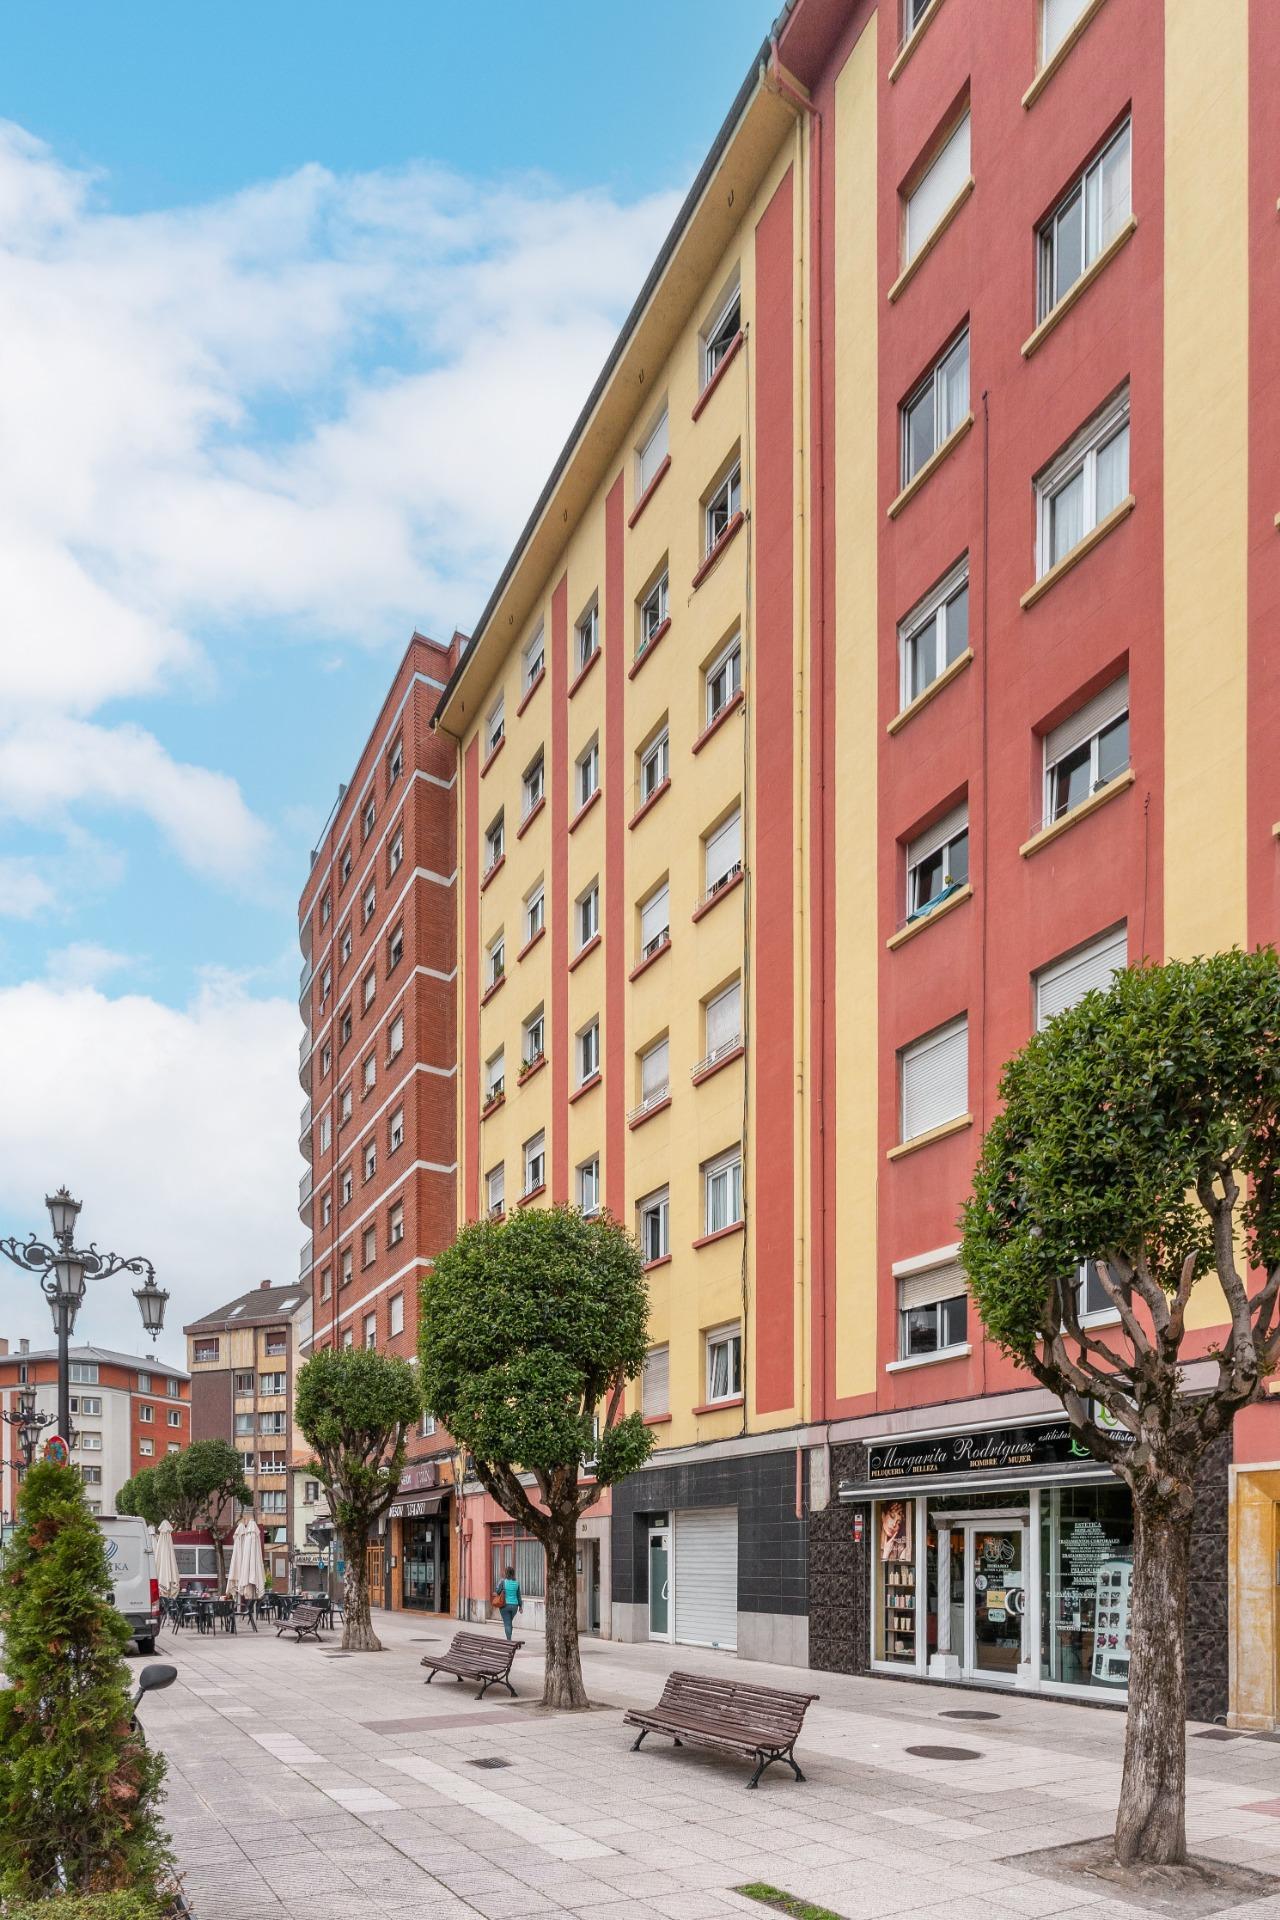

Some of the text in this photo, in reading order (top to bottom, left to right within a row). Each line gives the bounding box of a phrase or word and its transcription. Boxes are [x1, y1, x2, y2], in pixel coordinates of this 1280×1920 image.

[1038, 1429, 1071, 1441] estilistas
[1109, 1430, 1137, 1442] tilistas
[871, 1446, 947, 1473] Margarita
[871, 1454, 1032, 1477] PELUQUERIA BELLEZA HOMBRE MUJER
